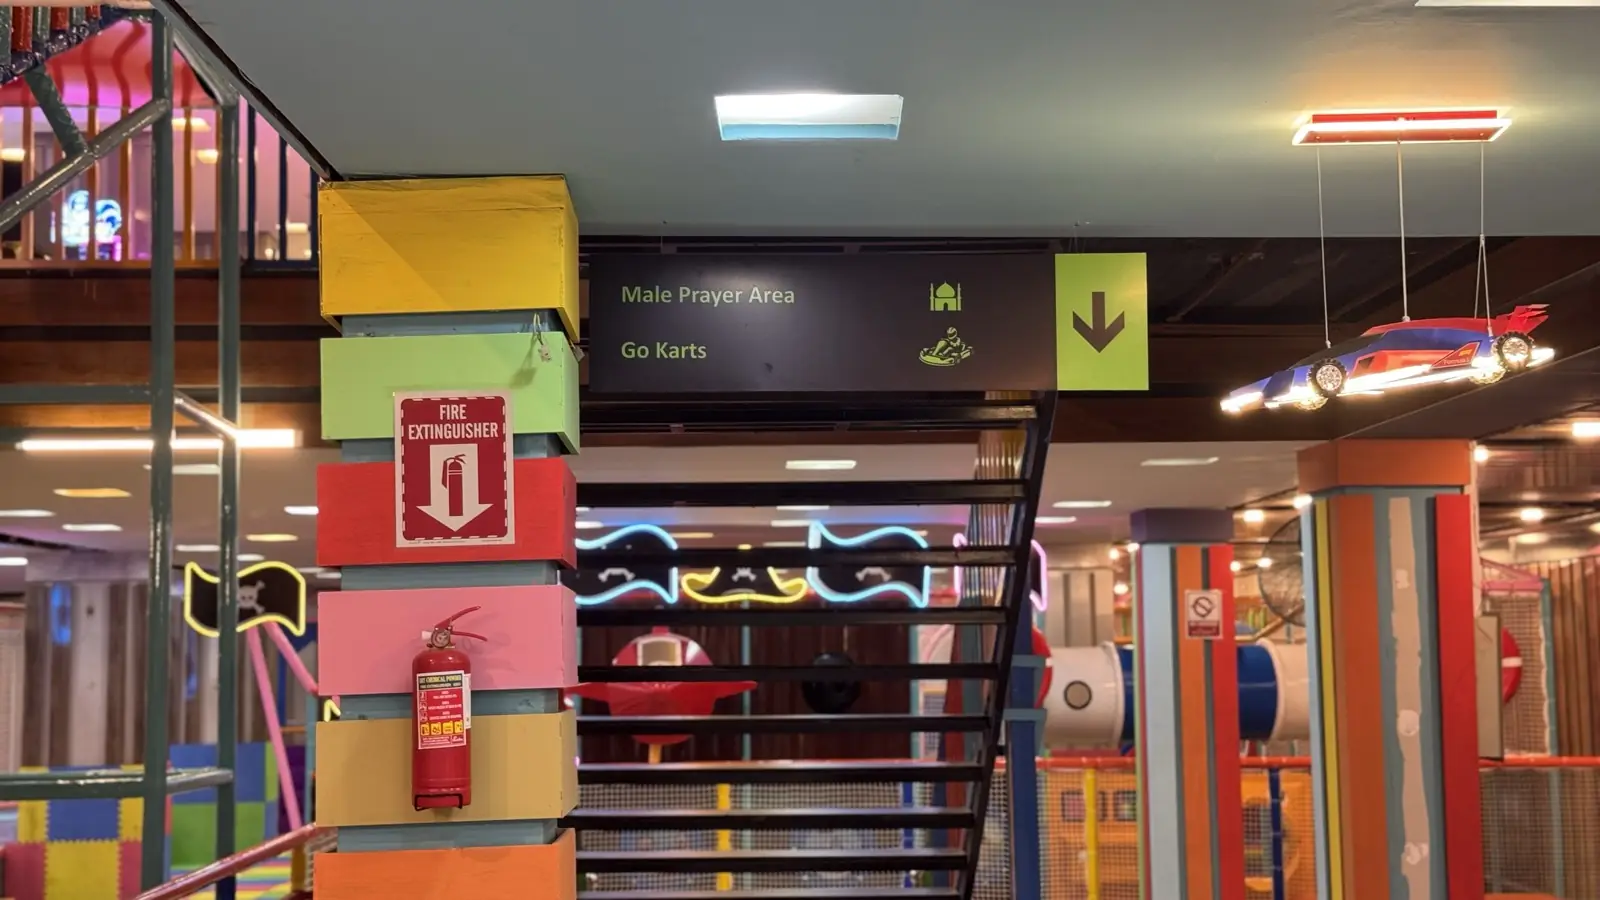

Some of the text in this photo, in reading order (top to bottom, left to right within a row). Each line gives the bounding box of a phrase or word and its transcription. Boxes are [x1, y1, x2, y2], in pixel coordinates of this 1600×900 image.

[621, 285, 795, 307] Male Prayer Area
[621, 341, 707, 359] Go Karts
[439, 404, 467, 420] FIRE
[408, 422, 499, 440] EXTINGUISHER
